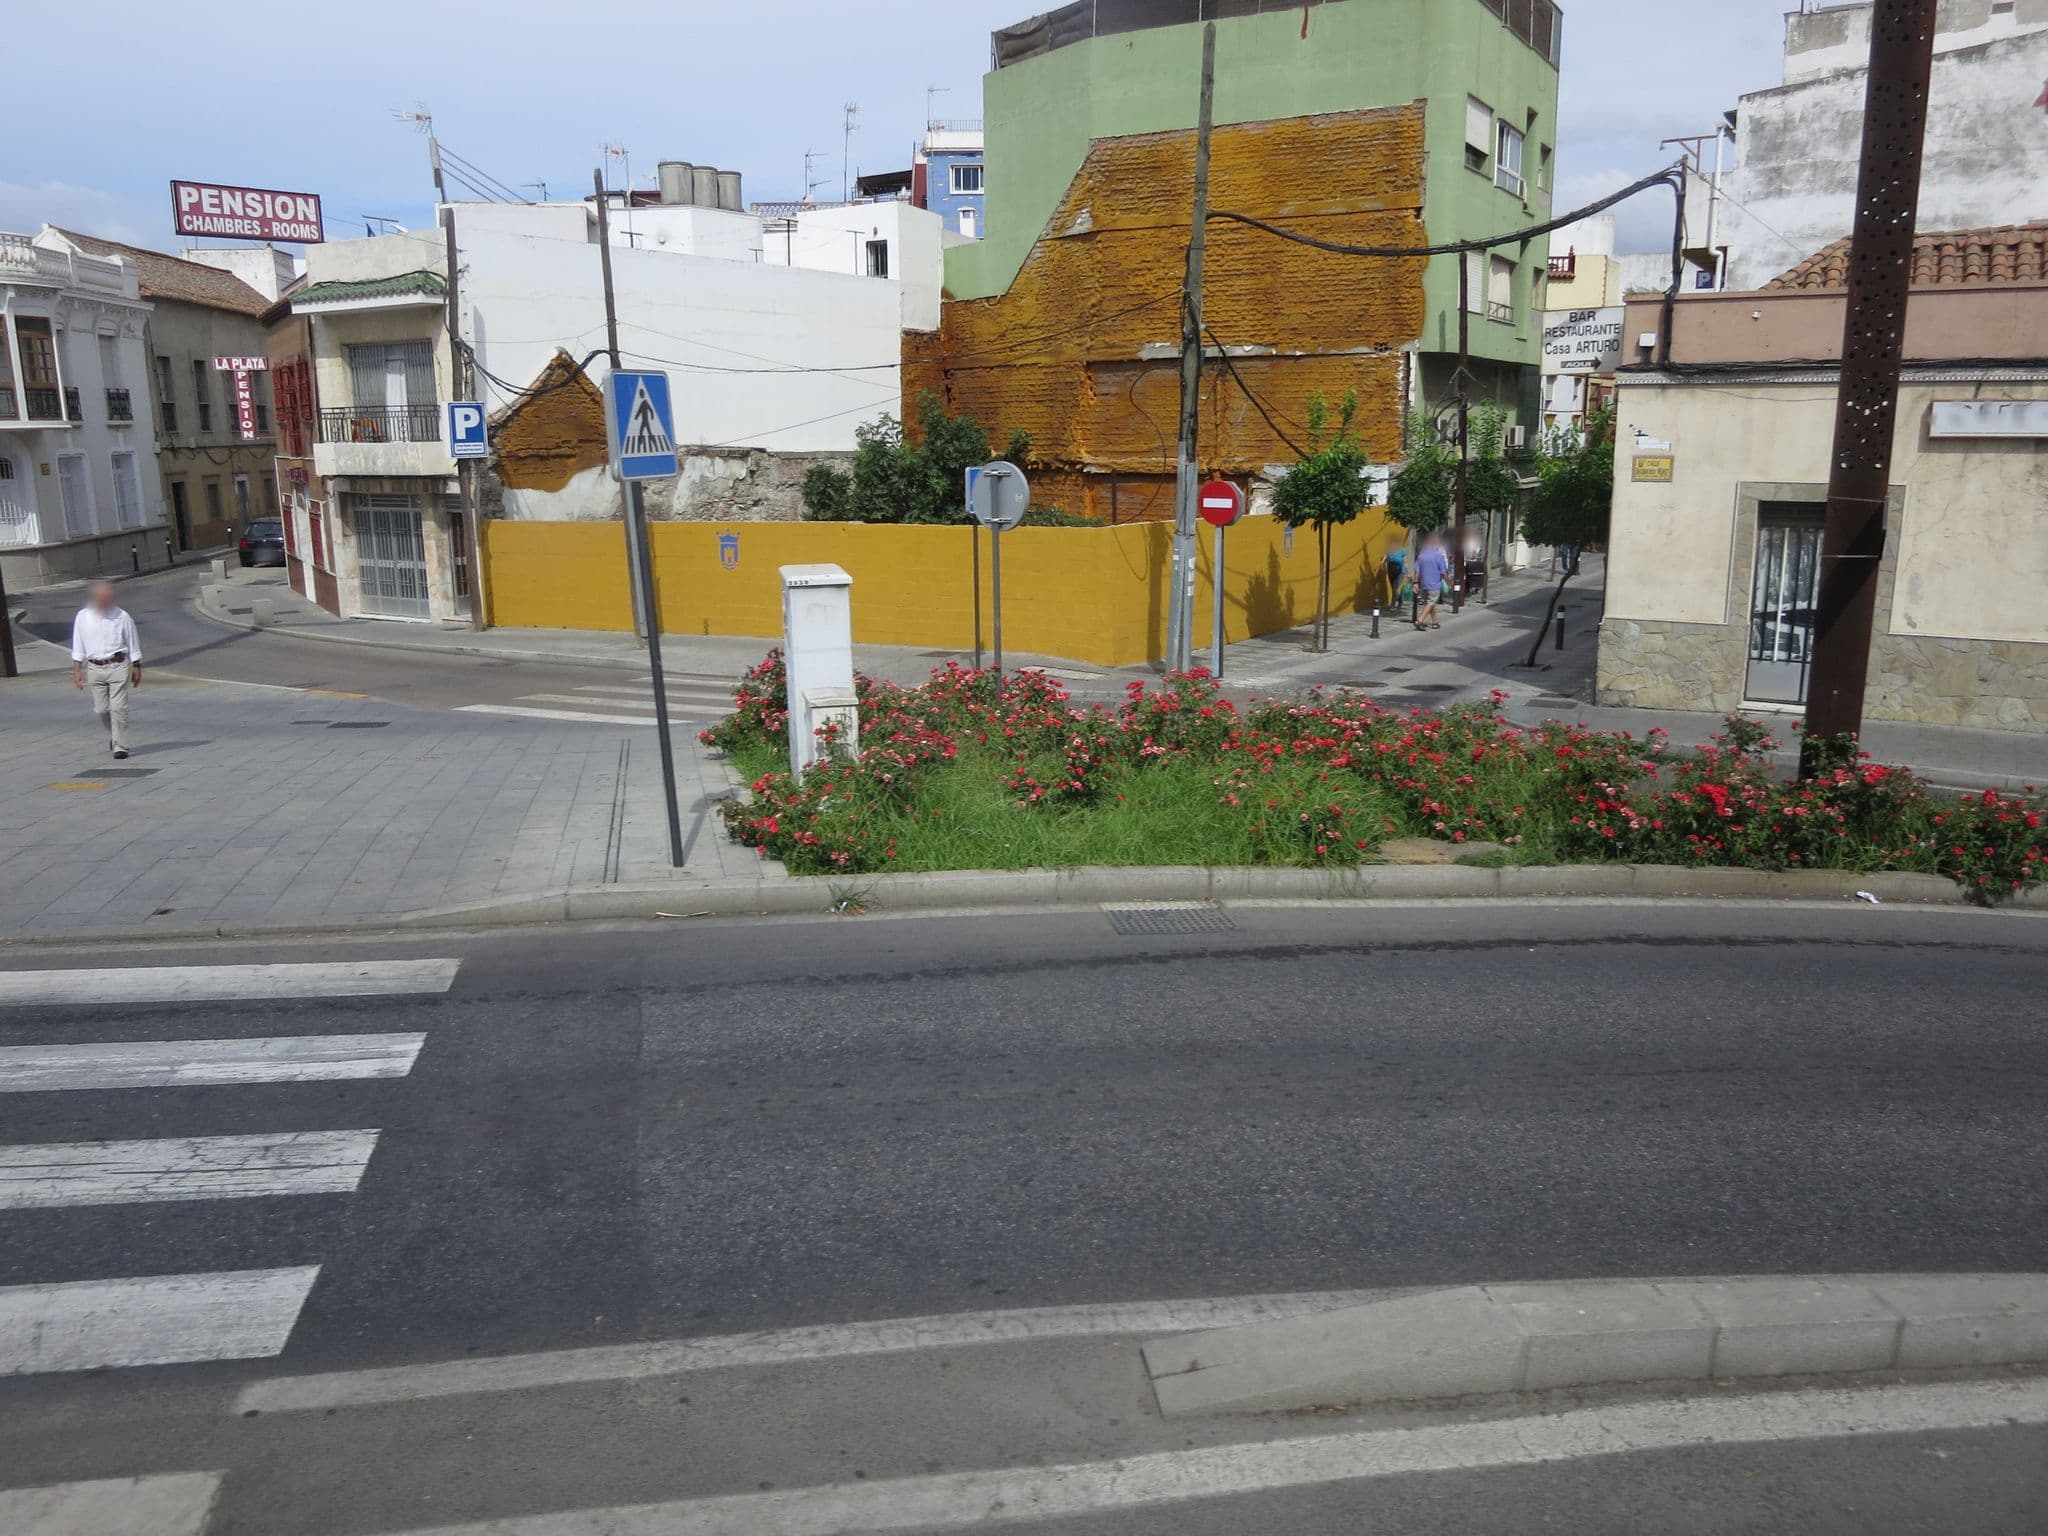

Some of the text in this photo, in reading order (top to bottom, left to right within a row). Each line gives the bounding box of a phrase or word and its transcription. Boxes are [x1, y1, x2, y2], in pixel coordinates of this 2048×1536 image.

[179, 186, 317, 222] PENSION
[183, 215, 261, 236] CHAMBRES
[272, 221, 319, 240] ROOMS
[1697, 272, 1711, 287] P
[1569, 311, 1596, 323] BAR
[1545, 324, 1621, 338] RESTAURANTE
[1545, 339, 1620, 355] Casa ARTURO
[214, 358, 265, 370] LA PLATA
[237, 371, 255, 438] PENSION
[454, 407, 480, 440] P
